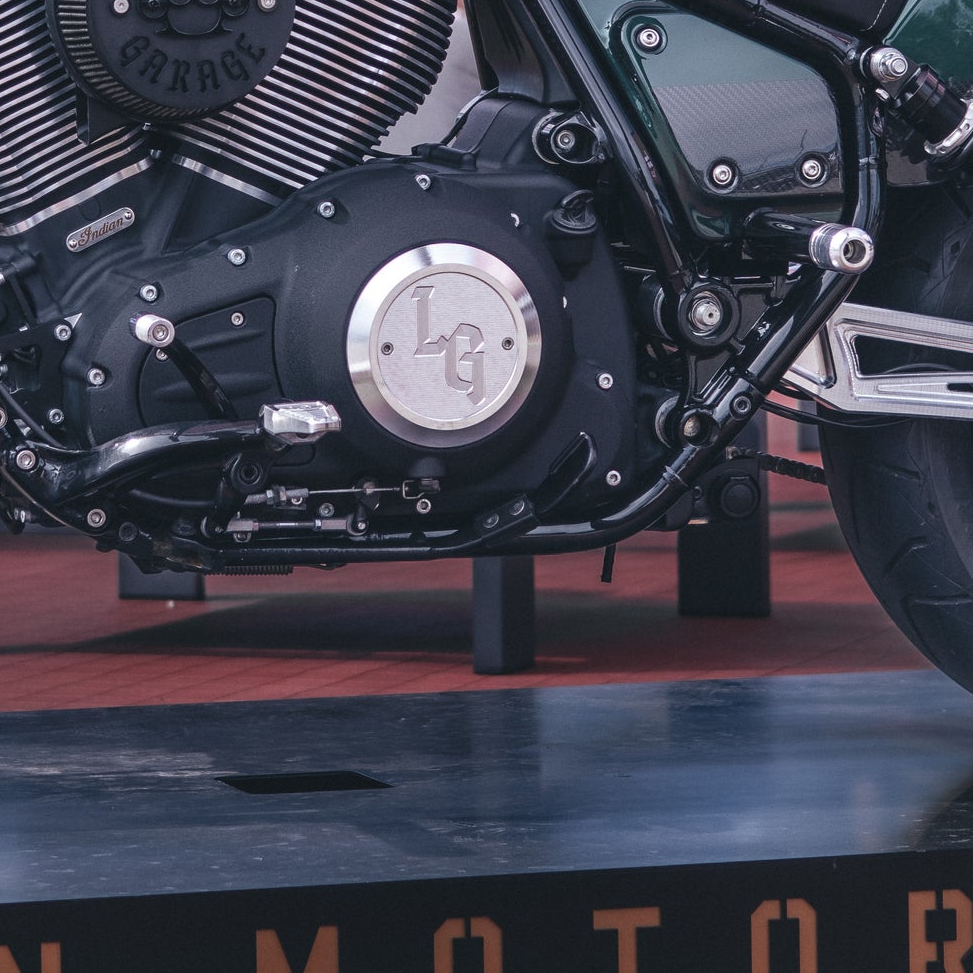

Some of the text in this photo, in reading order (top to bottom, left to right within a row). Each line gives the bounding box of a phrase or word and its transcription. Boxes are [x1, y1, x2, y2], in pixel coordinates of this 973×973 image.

[120, 32, 266, 93] GARAGE
[78, 217, 124, 246] Indian
[411, 285, 486, 406] LG
